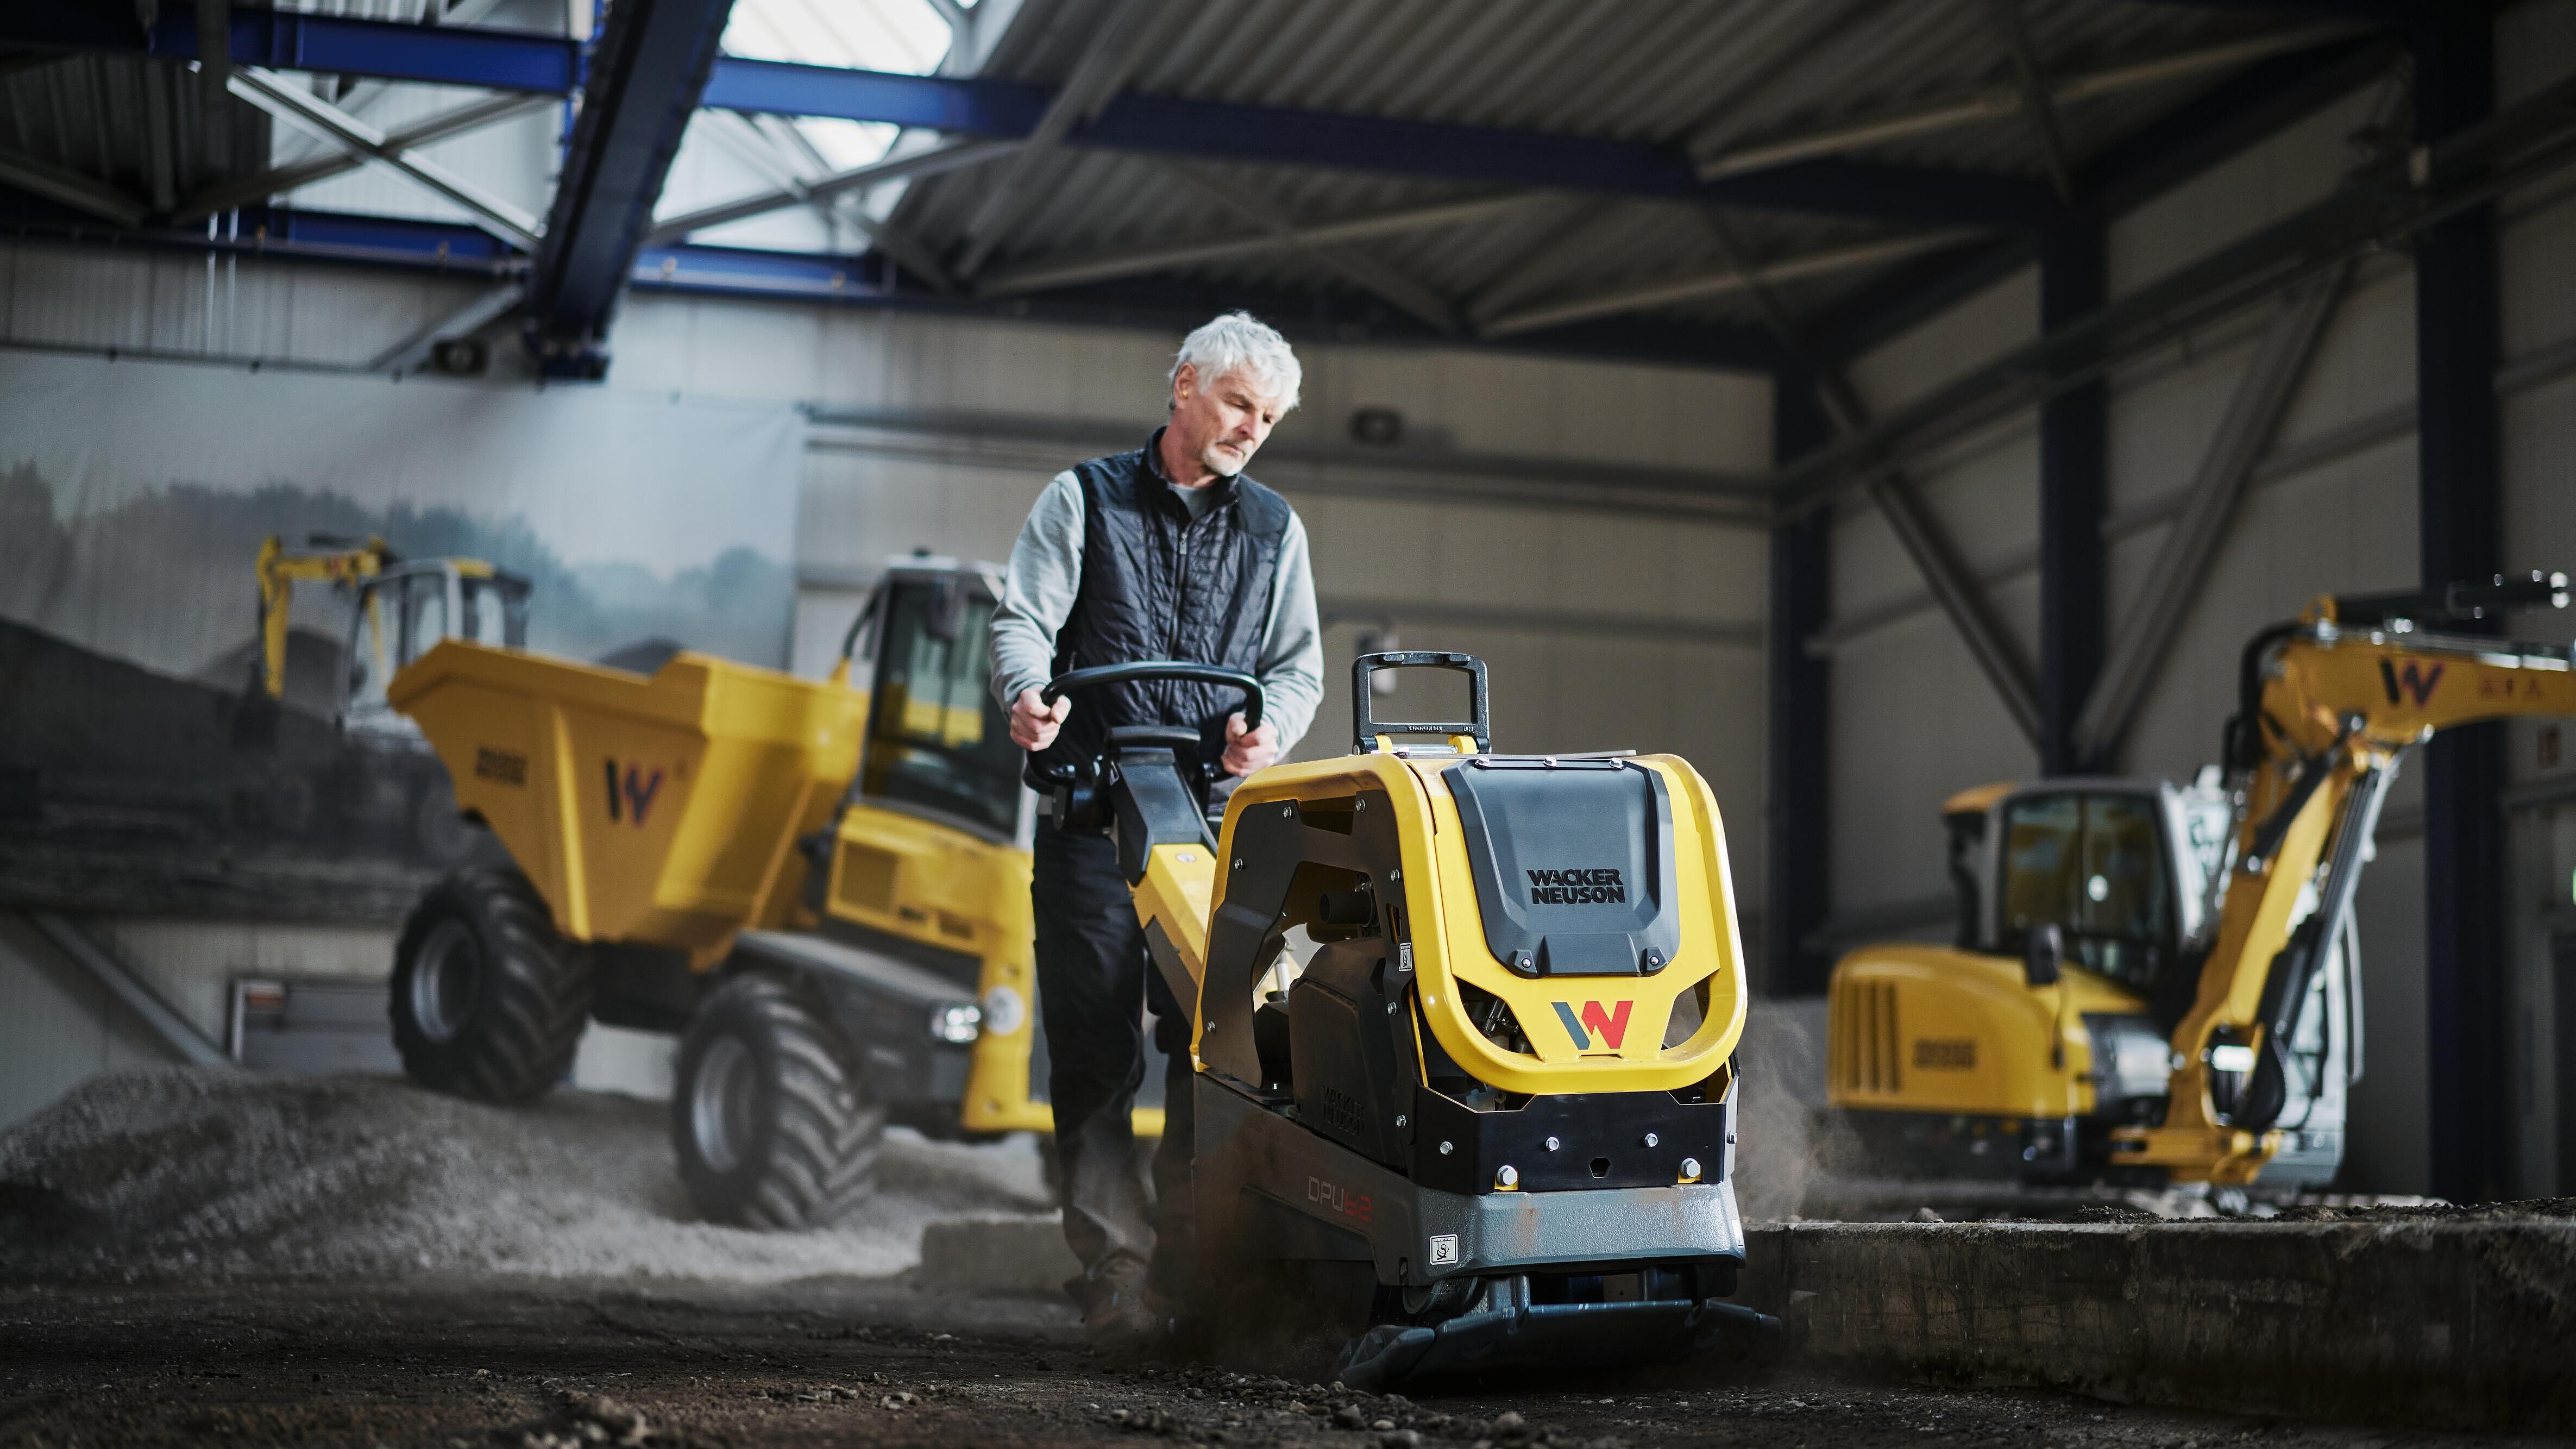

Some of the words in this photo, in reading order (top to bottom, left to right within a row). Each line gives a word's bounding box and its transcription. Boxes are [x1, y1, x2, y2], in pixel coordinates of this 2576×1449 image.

[1526, 869, 1623, 886] WACKER
[1531, 886, 1625, 905] NEUSON
[1551, 1001, 1633, 1050] W
